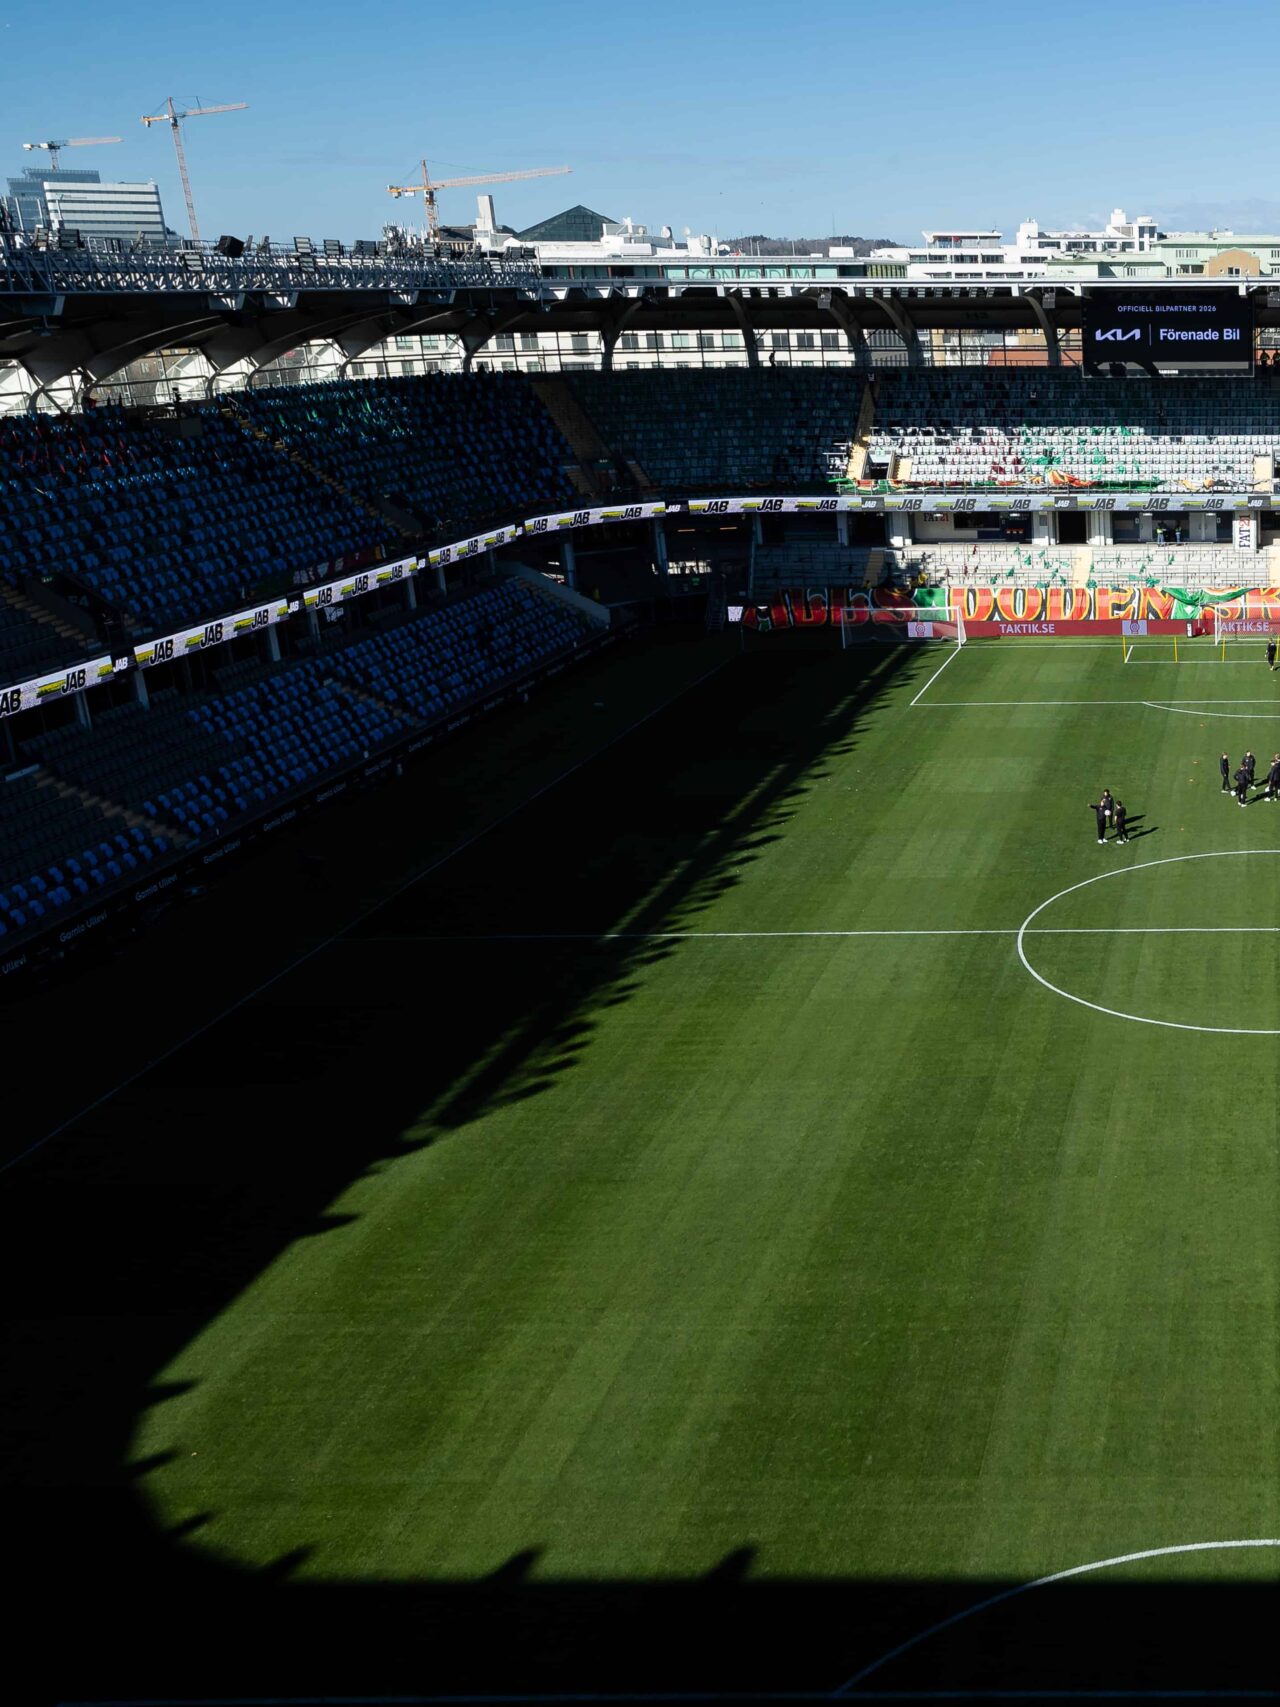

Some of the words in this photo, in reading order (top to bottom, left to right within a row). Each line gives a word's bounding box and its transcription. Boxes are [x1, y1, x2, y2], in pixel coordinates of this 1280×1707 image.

[1095, 328, 1141, 341] KIA
[1159, 328, 1219, 341] Förenade
[1223, 328, 1240, 341] Bil
[666, 504, 681, 512] JAB
[702, 500, 729, 513] JAB
[757, 499, 783, 512] JAB
[816, 499, 838, 511] JAB
[862, 500, 877, 509] JAB
[897, 498, 923, 511] JAB
[949, 498, 977, 511] JAB
[1008, 499, 1031, 510] JAB
[1055, 499, 1070, 508] JAB
[1090, 498, 1116, 510] JAB
[1142, 498, 1170, 510] JAB
[1201, 498, 1224, 509] JAB
[1248, 499, 1263, 507] JAB
[570, 512, 590, 527] JAB
[620, 507, 642, 520] JAB
[531, 518, 548, 534] JAB
[1239, 514, 1251, 548] FAT21
[494, 531, 505, 546] JAB
[466, 539, 478, 556] JAB
[437, 548, 451, 565] JAB
[389, 564, 403, 581] JAB
[352, 575, 369, 595] JAB
[315, 587, 333, 608] JAB
[251, 609, 269, 629] JAB
[200, 622, 223, 648] JAB
[1000, 623, 1055, 634] TAKTIK.SE
[149, 639, 174, 665] JAB
[113, 656, 129, 673] JAB
[61, 669, 86, 694] JAB
[85, 907, 109, 928] Ullevi
[1, 954, 27, 975] Ullevi
